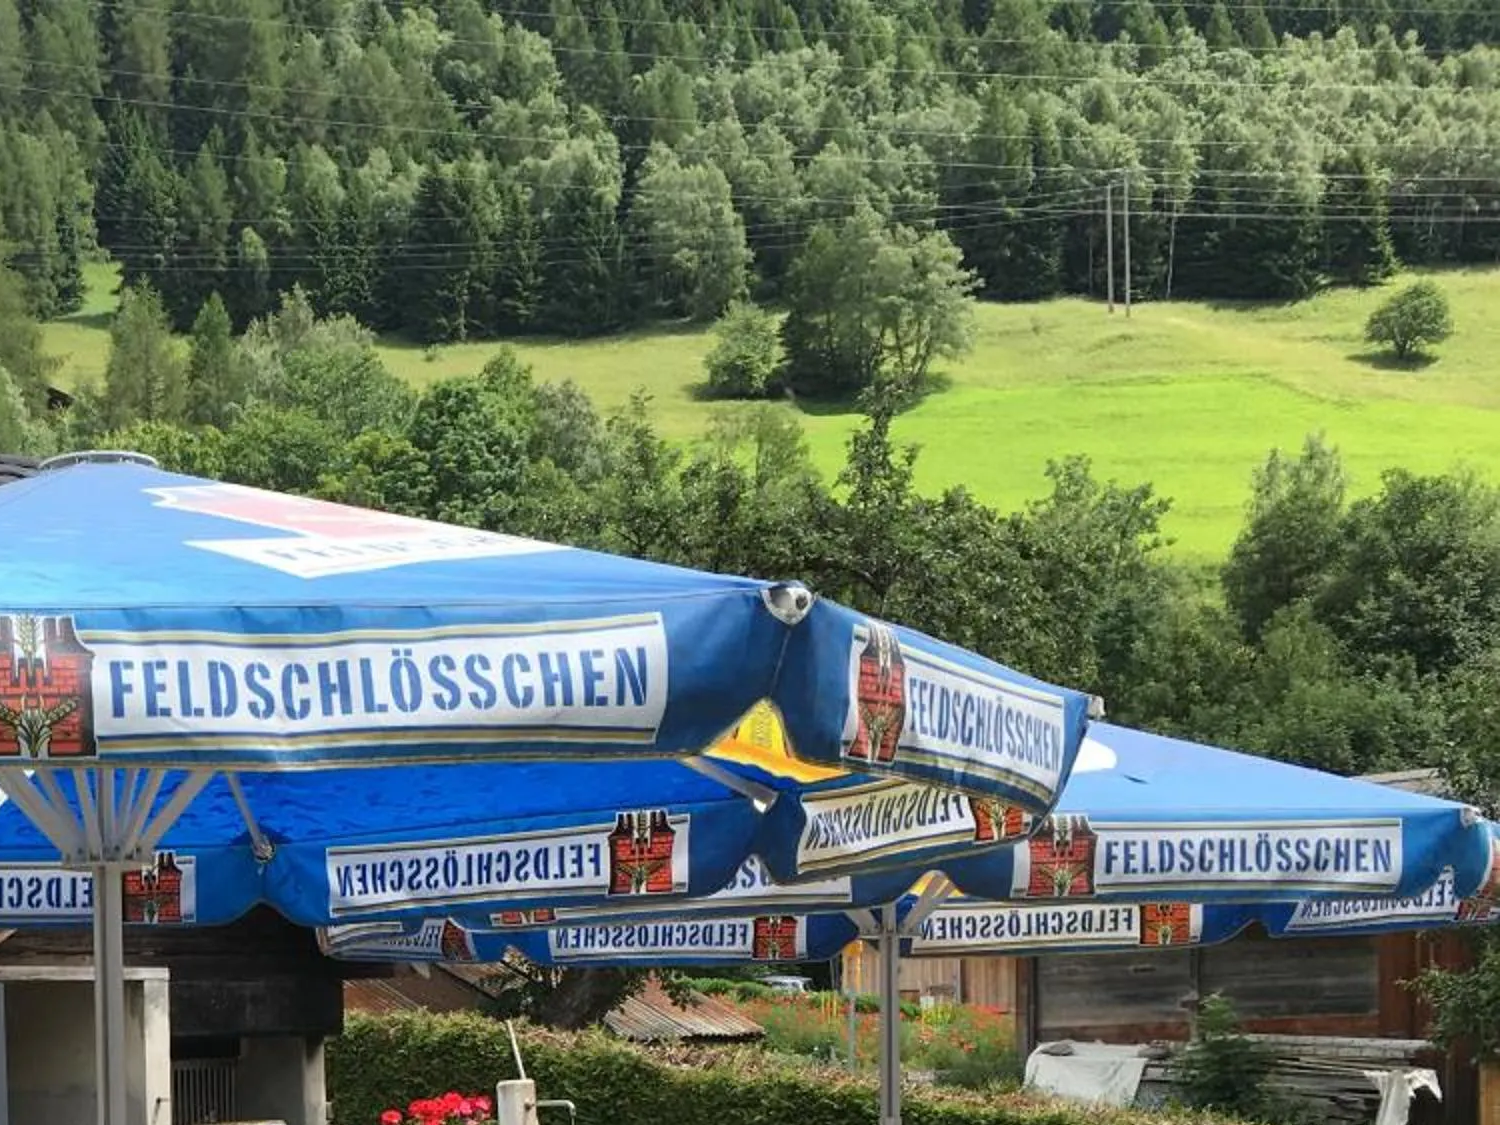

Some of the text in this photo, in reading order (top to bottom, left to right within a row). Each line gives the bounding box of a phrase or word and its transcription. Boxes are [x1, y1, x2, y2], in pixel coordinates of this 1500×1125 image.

[108, 645, 647, 720] FELDSCHLÖSSCHEN
[910, 676, 1061, 772] FELDSCHLÖSSCHEN
[1104, 832, 1393, 876] FELDSCHLÖSSCHEN
